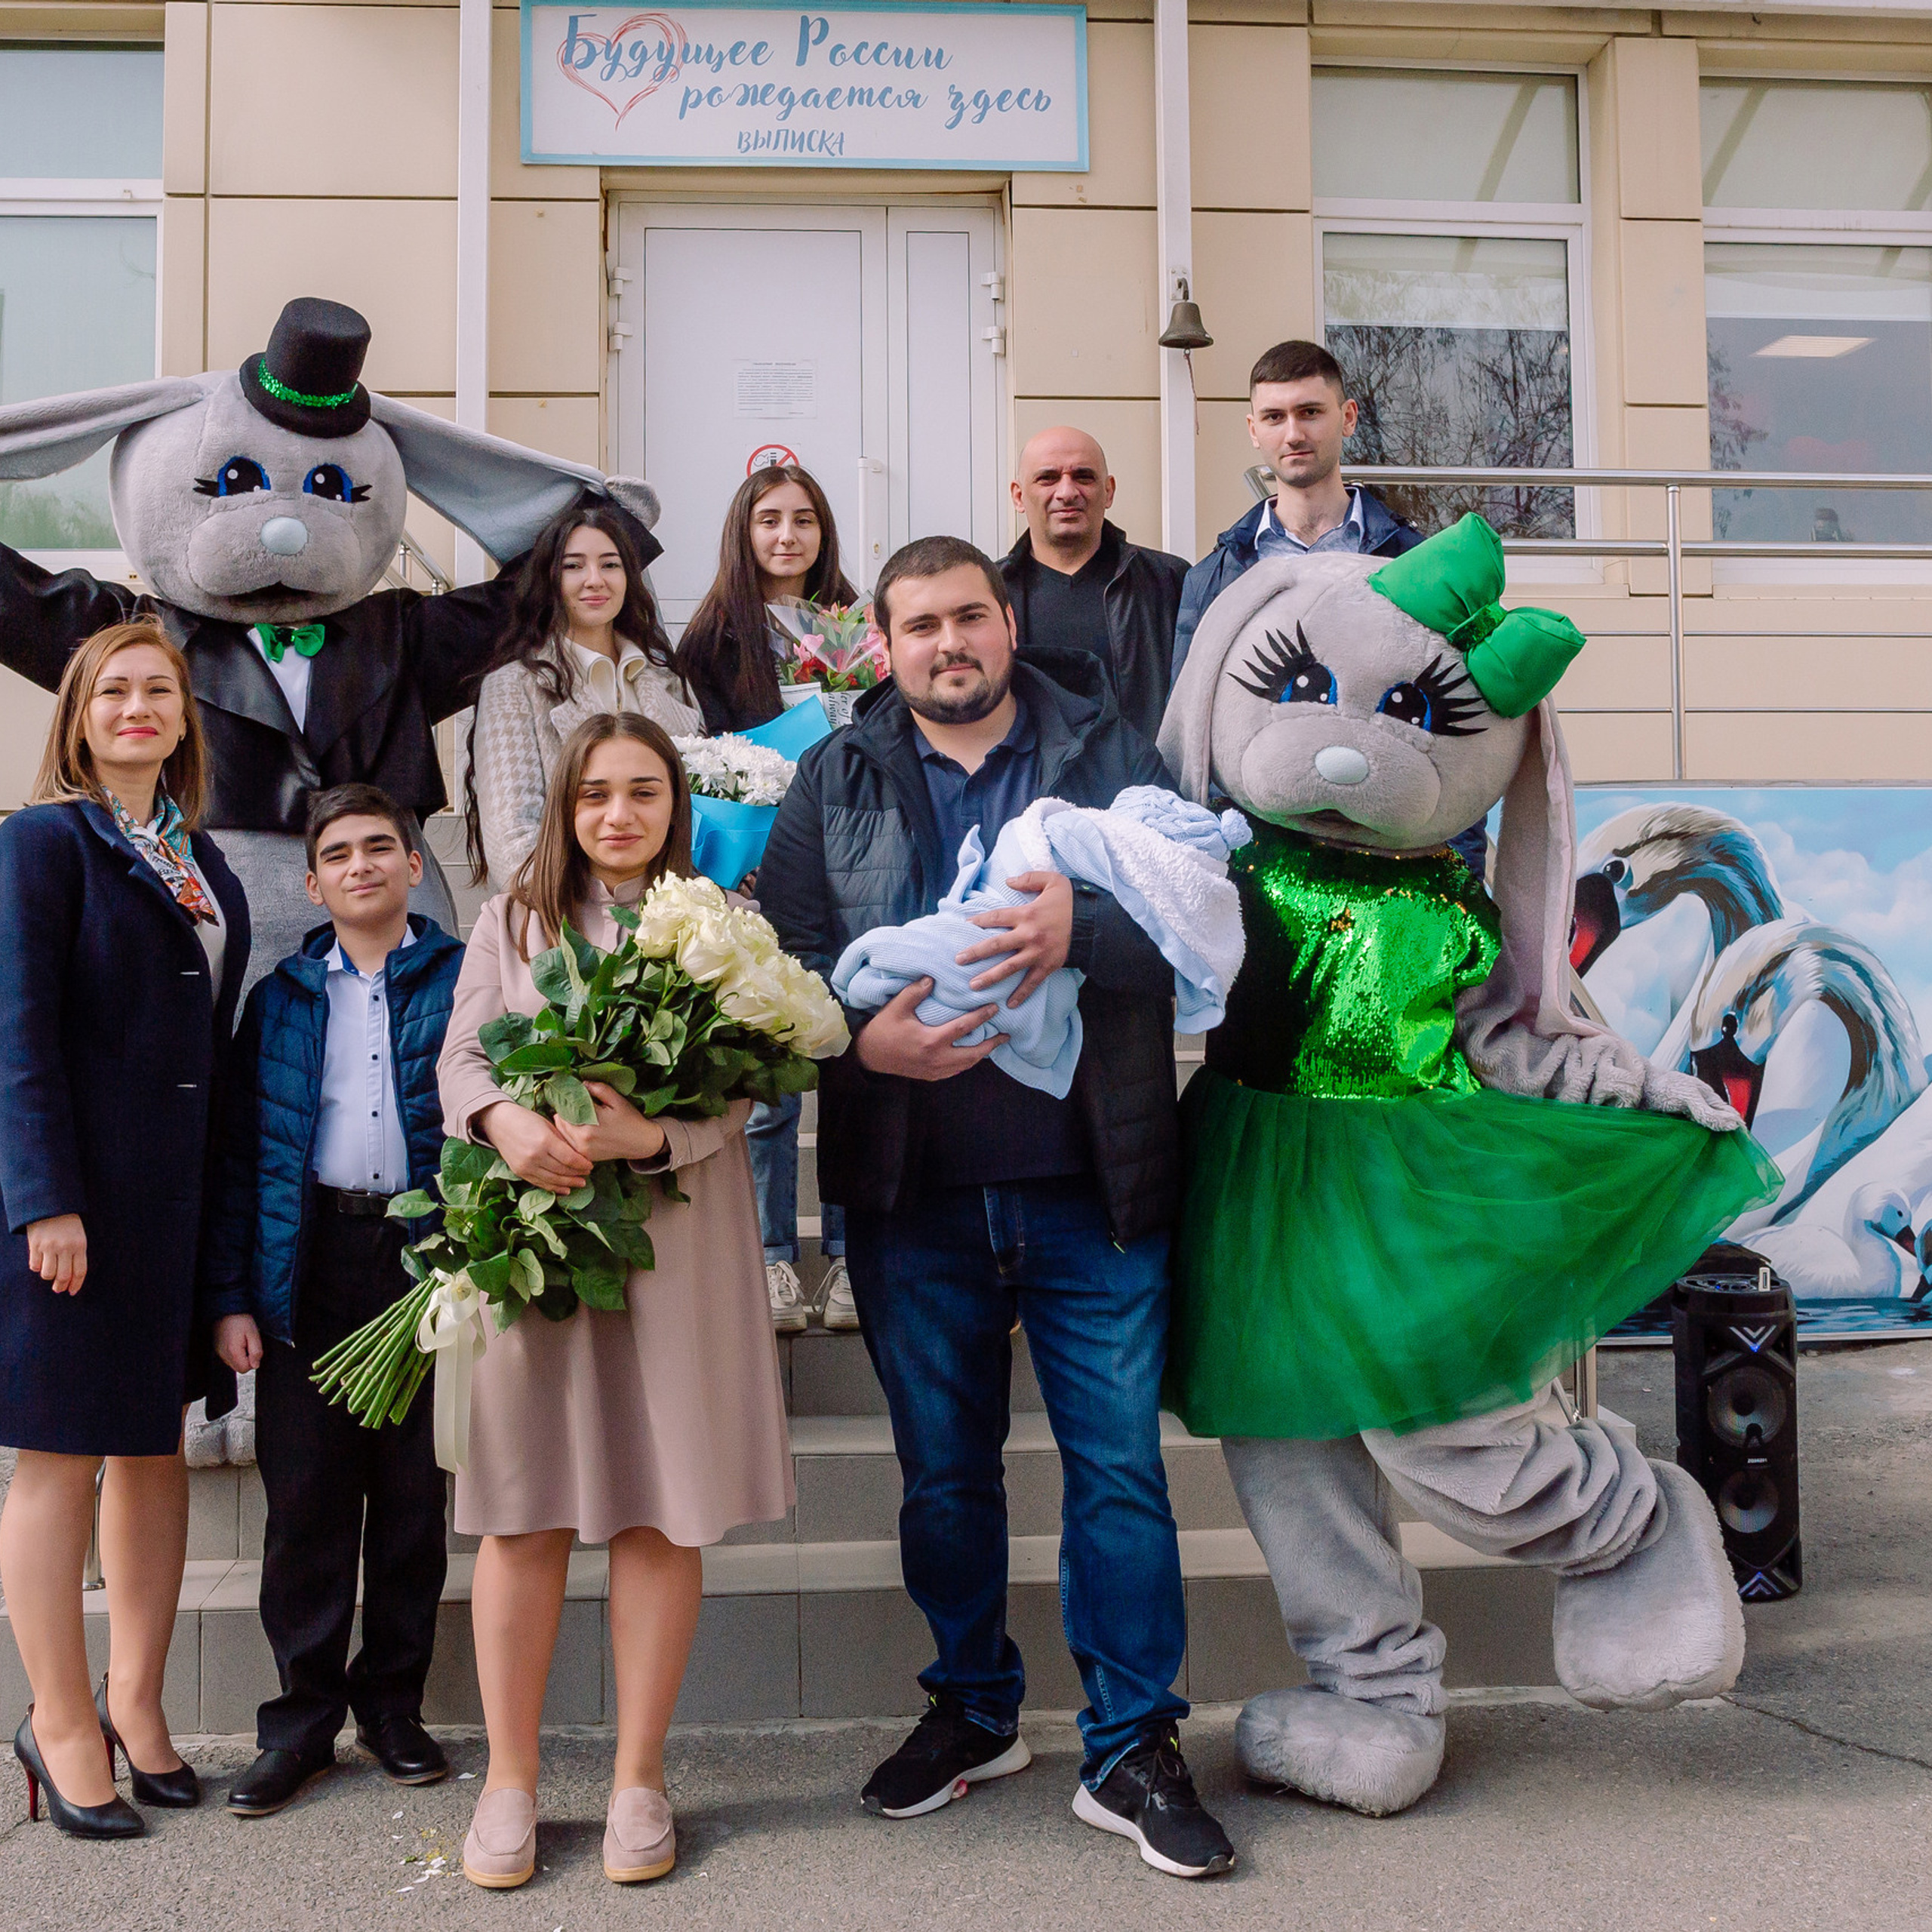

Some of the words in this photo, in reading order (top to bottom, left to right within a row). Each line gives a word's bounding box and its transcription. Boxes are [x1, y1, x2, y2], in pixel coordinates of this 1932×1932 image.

[563, 14, 774, 83] Будущее
[795, 15, 954, 69] России
[679, 82, 928, 121] рождается
[944, 83, 1051, 130] здесь
[737, 129, 845, 156] ВЫПИСКА
